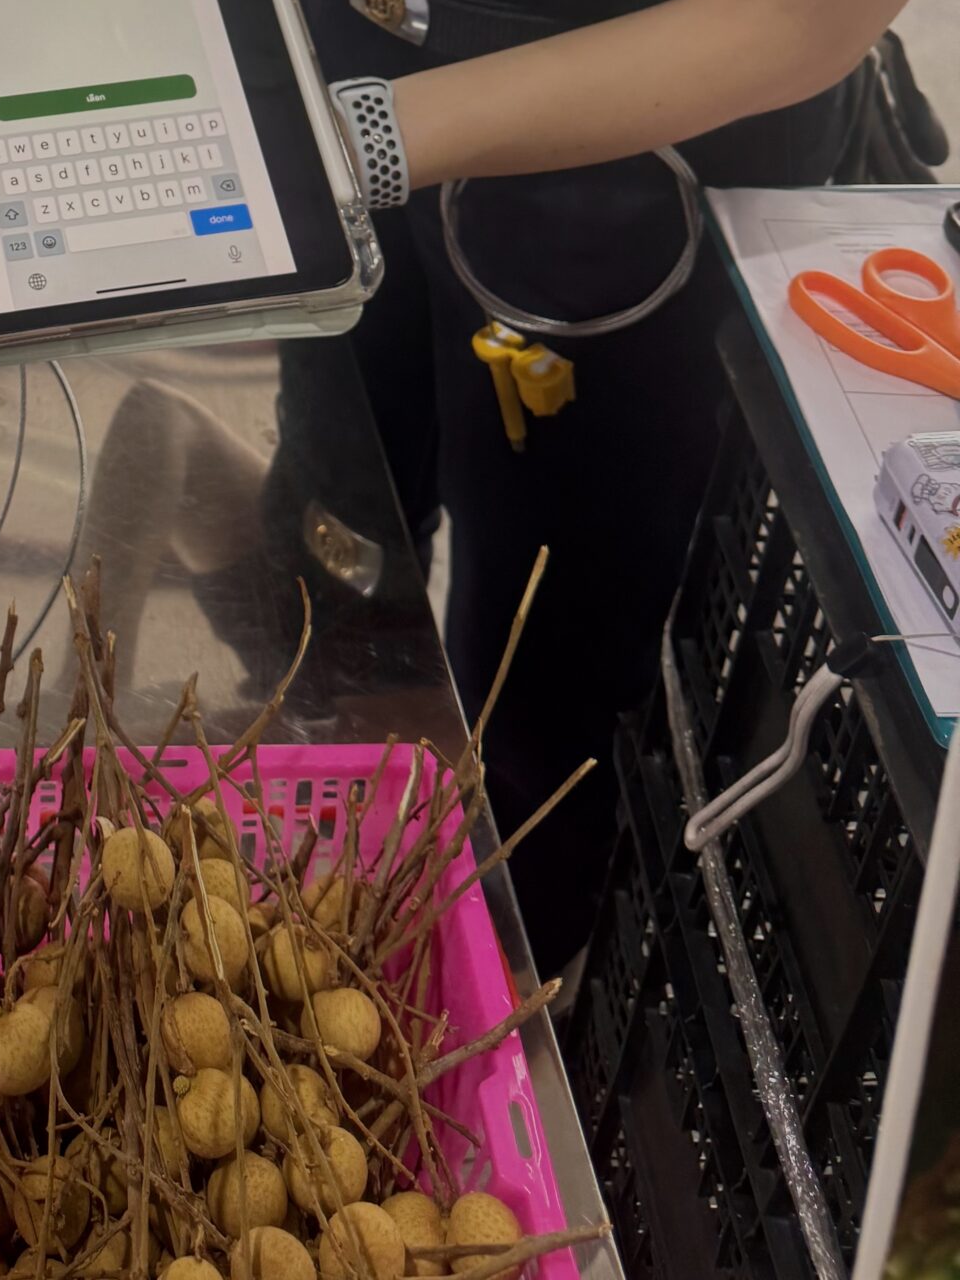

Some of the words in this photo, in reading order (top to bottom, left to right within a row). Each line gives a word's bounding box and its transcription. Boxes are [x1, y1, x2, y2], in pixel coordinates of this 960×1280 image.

[85, 91, 107, 104] เลือก
[209, 213, 235, 226] done
[9, 241, 28, 252] 123
